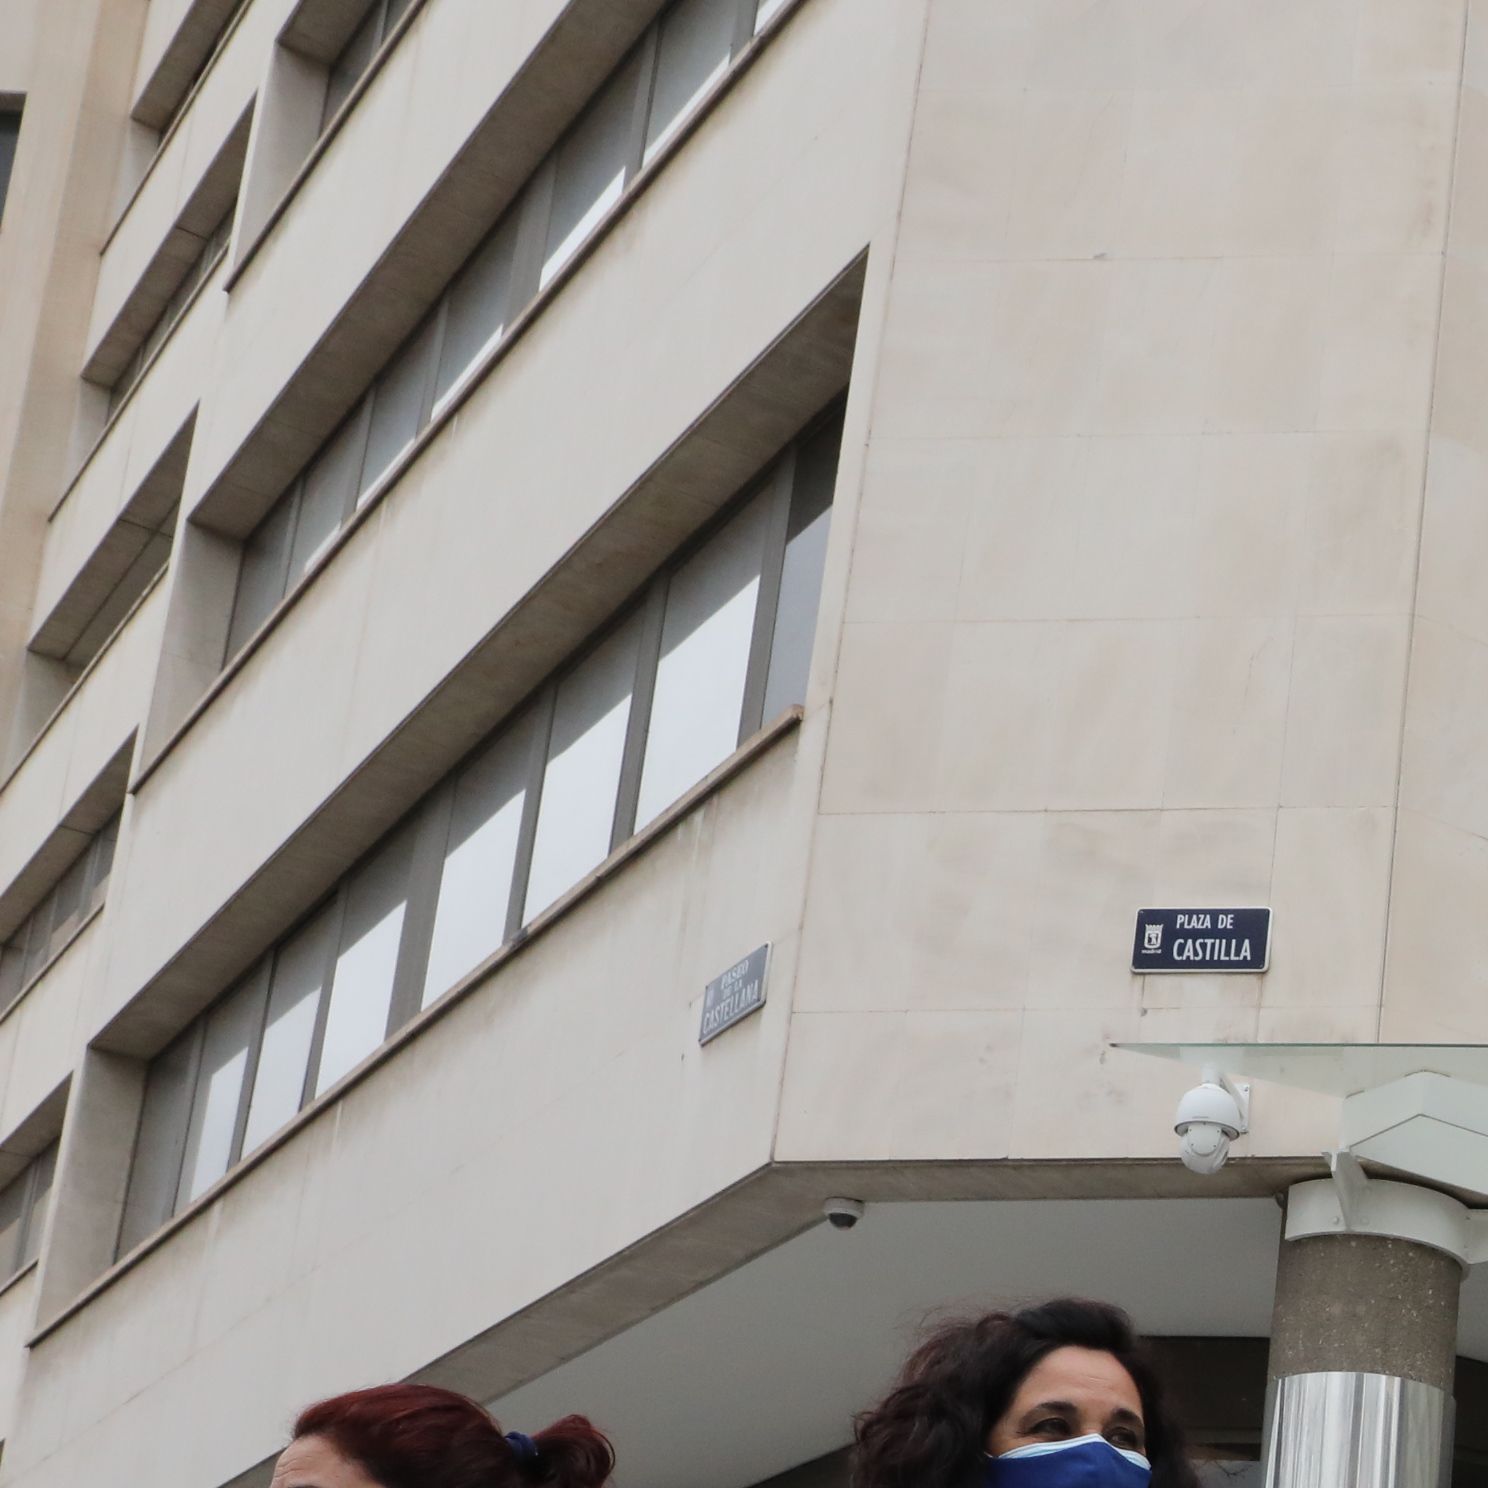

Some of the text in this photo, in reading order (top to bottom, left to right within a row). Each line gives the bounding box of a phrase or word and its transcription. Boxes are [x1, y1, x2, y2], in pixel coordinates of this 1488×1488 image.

[1176, 914, 1235, 929] PLAZA DE
[1172, 938, 1251, 961] CASTILLA
